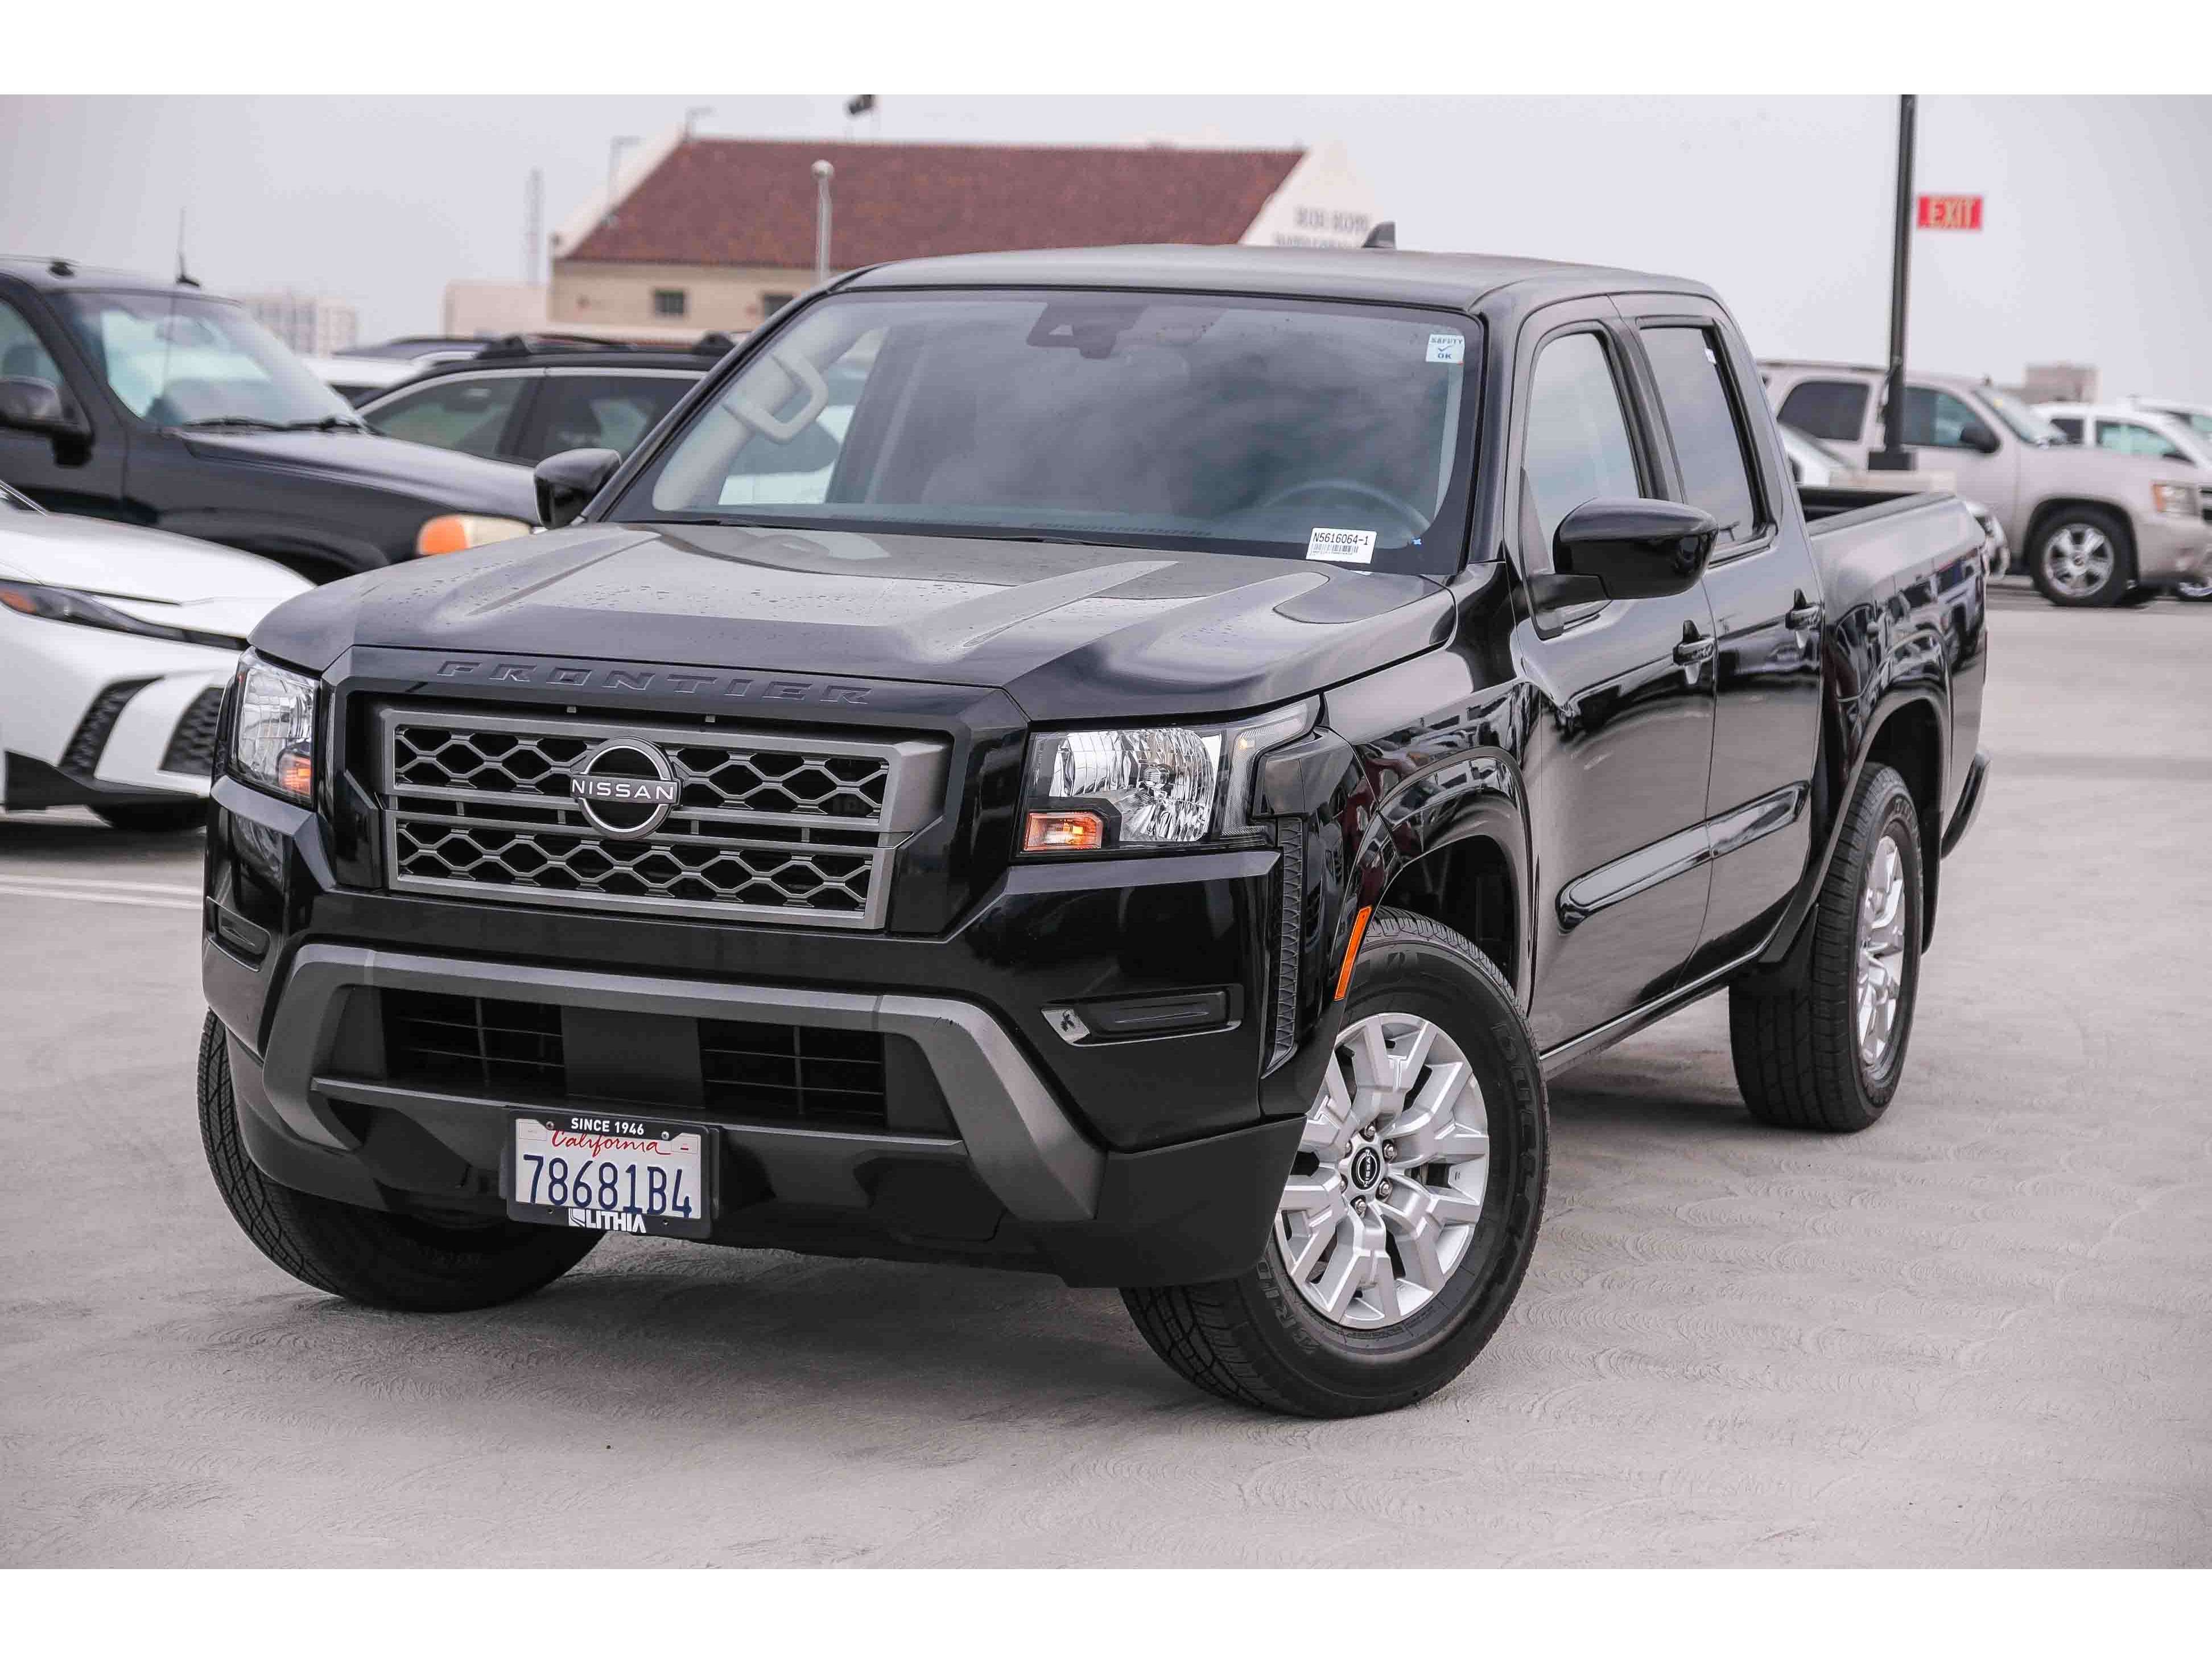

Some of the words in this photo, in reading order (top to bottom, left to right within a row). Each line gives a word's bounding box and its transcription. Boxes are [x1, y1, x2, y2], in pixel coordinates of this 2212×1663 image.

[1929, 198, 1974, 227] EXIT
[1313, 532, 1369, 545] N5616064-1
[437, 661, 874, 703] FRONTIER
[571, 778, 675, 800] NISSAN
[571, 1117, 610, 1133] SINCE
[614, 1122, 645, 1136] 1946
[551, 1130, 672, 1157] California
[523, 1154, 693, 1219] 78681B4
[586, 1209, 647, 1233] LITHIA
